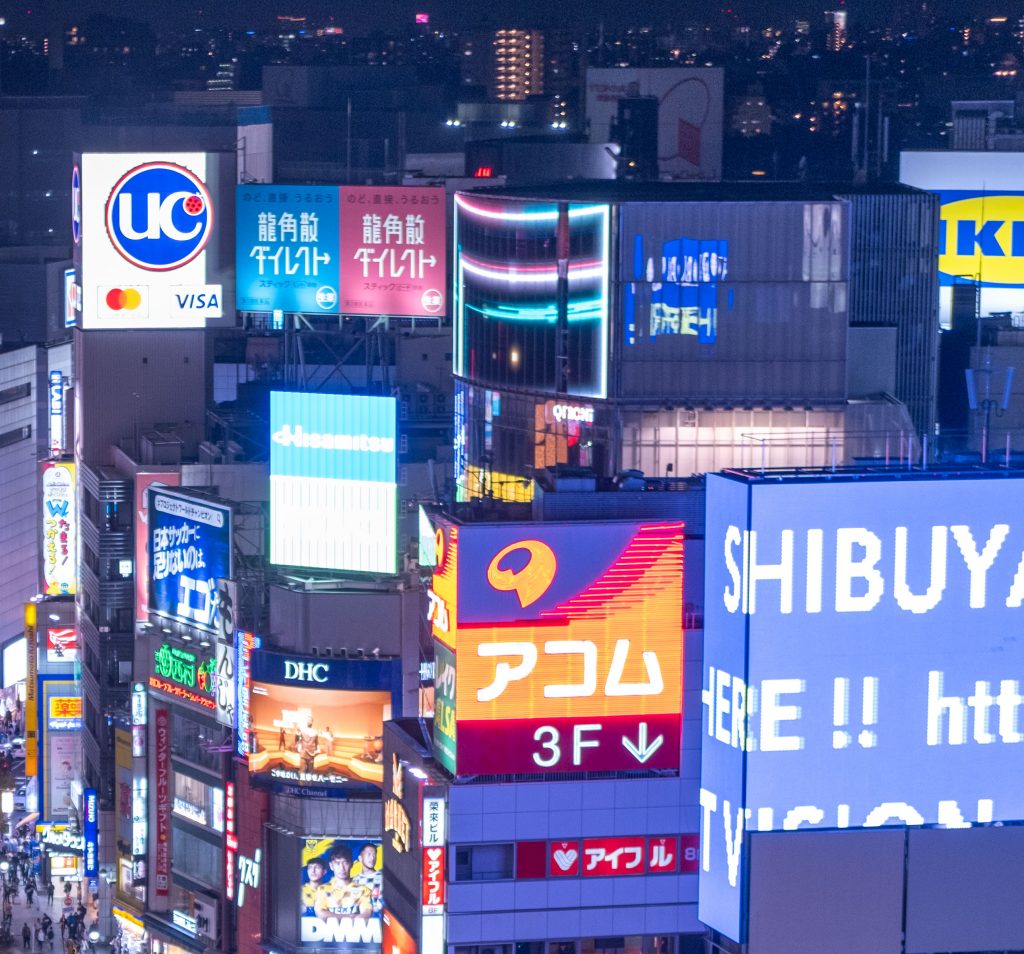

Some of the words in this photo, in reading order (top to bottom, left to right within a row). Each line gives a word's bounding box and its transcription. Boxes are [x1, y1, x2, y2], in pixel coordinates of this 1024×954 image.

[257, 211, 319, 243] 龍角散
[362, 213, 425, 245] 龍角散
[249, 246, 331, 276] ダイレクト
[353, 248, 437, 280] ダイレクト
[175, 293, 219, 309] VISA
[153, 522, 201, 553] 日本サッカーに
[153, 545, 206, 581] 足りないのは、
[723, 524, 1024, 614] SHIBUY
[284, 660, 329, 683] DHC
[477, 639, 664, 702] アコム
[532, 724, 603, 768] 3F
[157, 728, 170, 833] ウィンターフルーツギフト
[87, 795, 96, 823] MIZUHO
[585, 845, 674, 871] アイフル
[428, 860, 441, 905] アイフル
[302, 917, 382, 943] DMM
